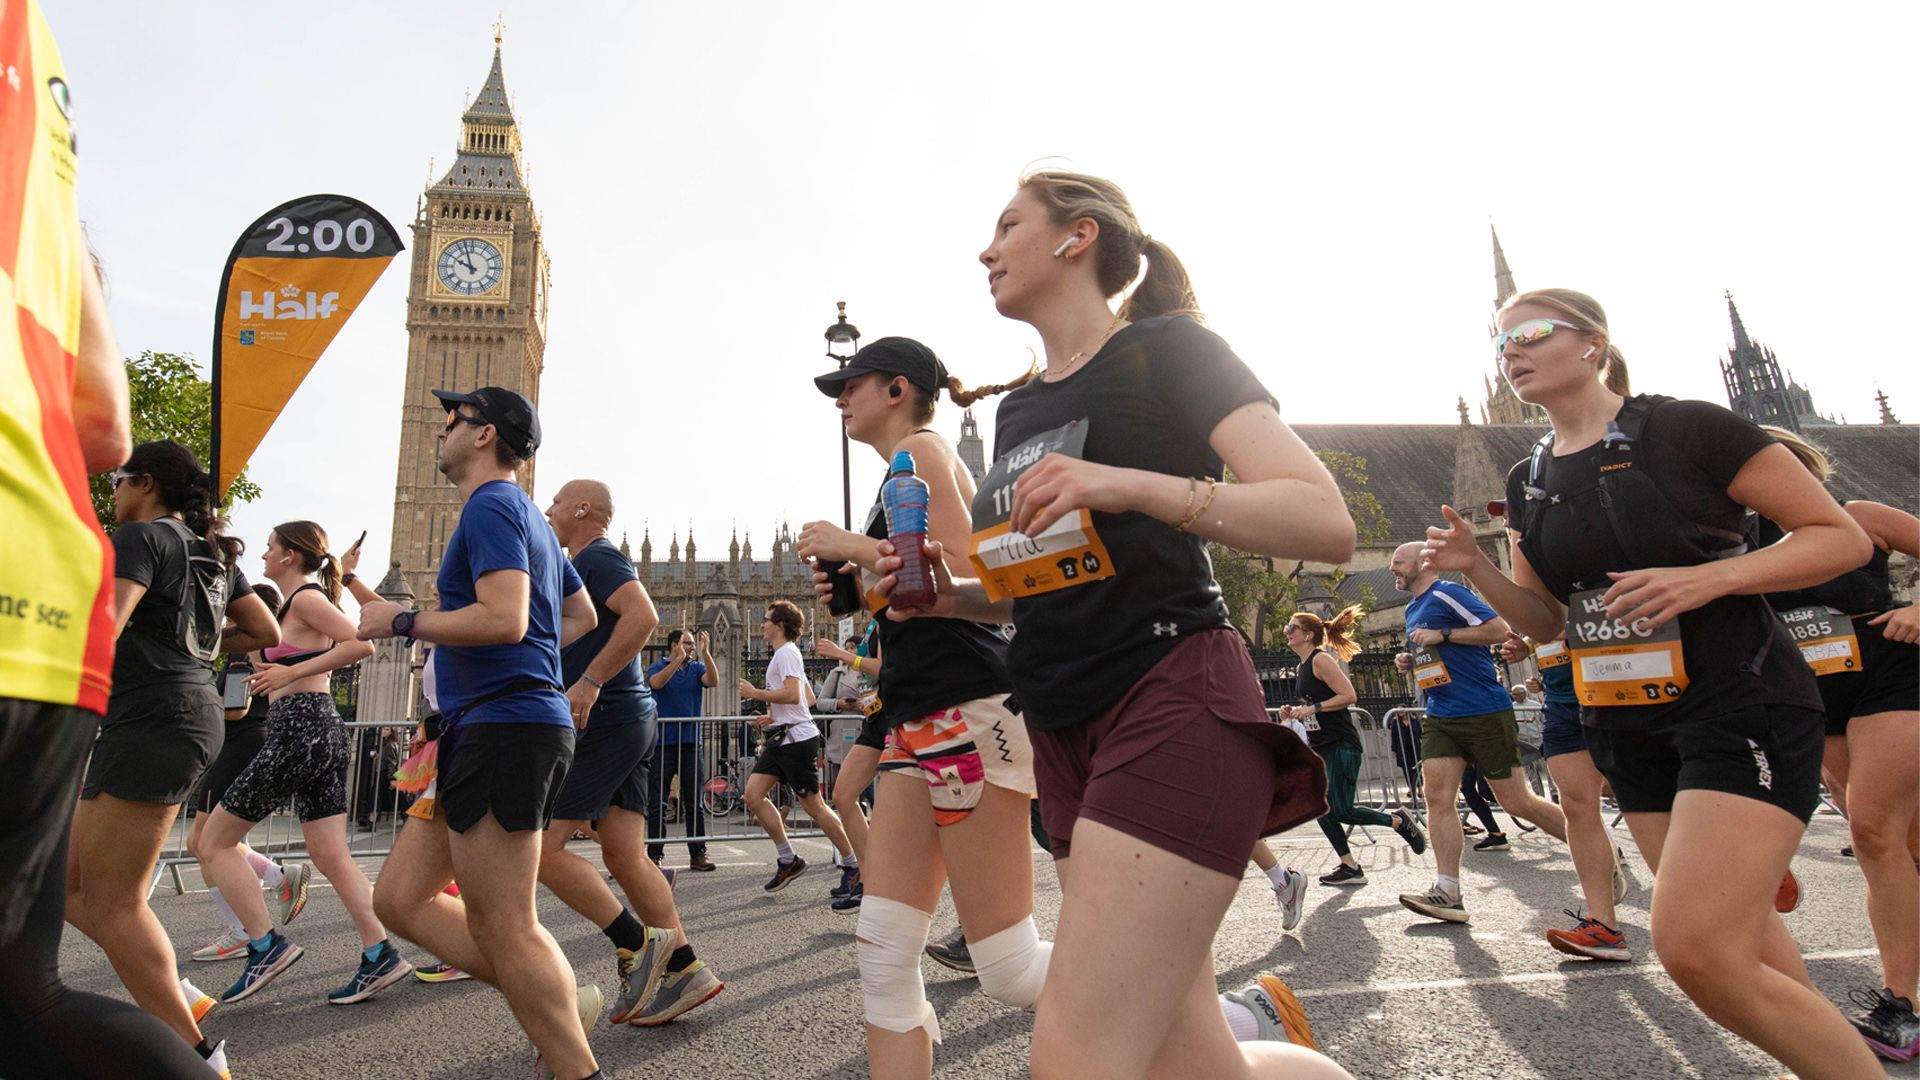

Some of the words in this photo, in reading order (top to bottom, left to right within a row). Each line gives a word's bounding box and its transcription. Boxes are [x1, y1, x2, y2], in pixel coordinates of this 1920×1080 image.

[266, 217, 375, 253] 2:00
[239, 290, 340, 320] Half
[1007, 442, 1044, 474] Half
[1065, 564, 1075, 576] 2
[1085, 558, 1098, 570] M
[1783, 610, 1815, 623] Half
[1788, 621, 1832, 640] 1885
[1648, 688, 1656, 697] 3
[1254, 993, 1281, 1025] HOKA
